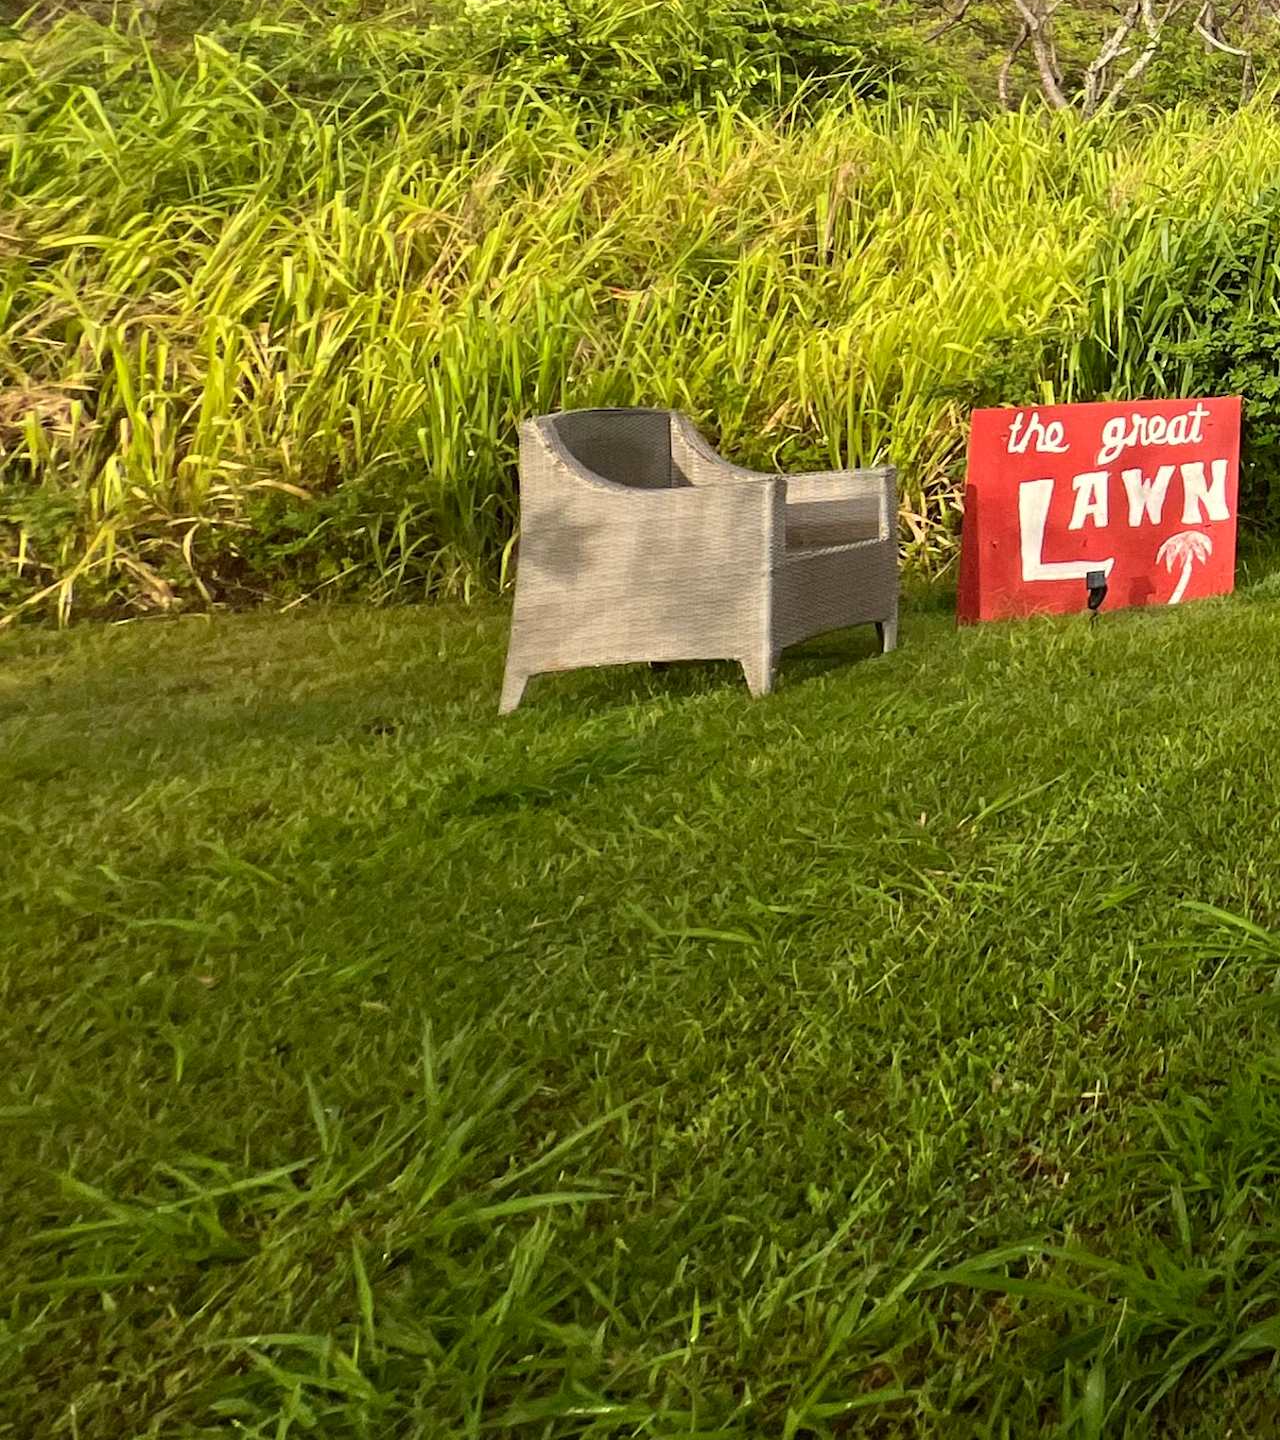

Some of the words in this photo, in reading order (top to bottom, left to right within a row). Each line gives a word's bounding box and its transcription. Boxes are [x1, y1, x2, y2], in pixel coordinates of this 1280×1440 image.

[1007, 411, 1070, 453] the
[1096, 402, 1210, 465] great
[1017, 459, 1231, 582] LAWN
